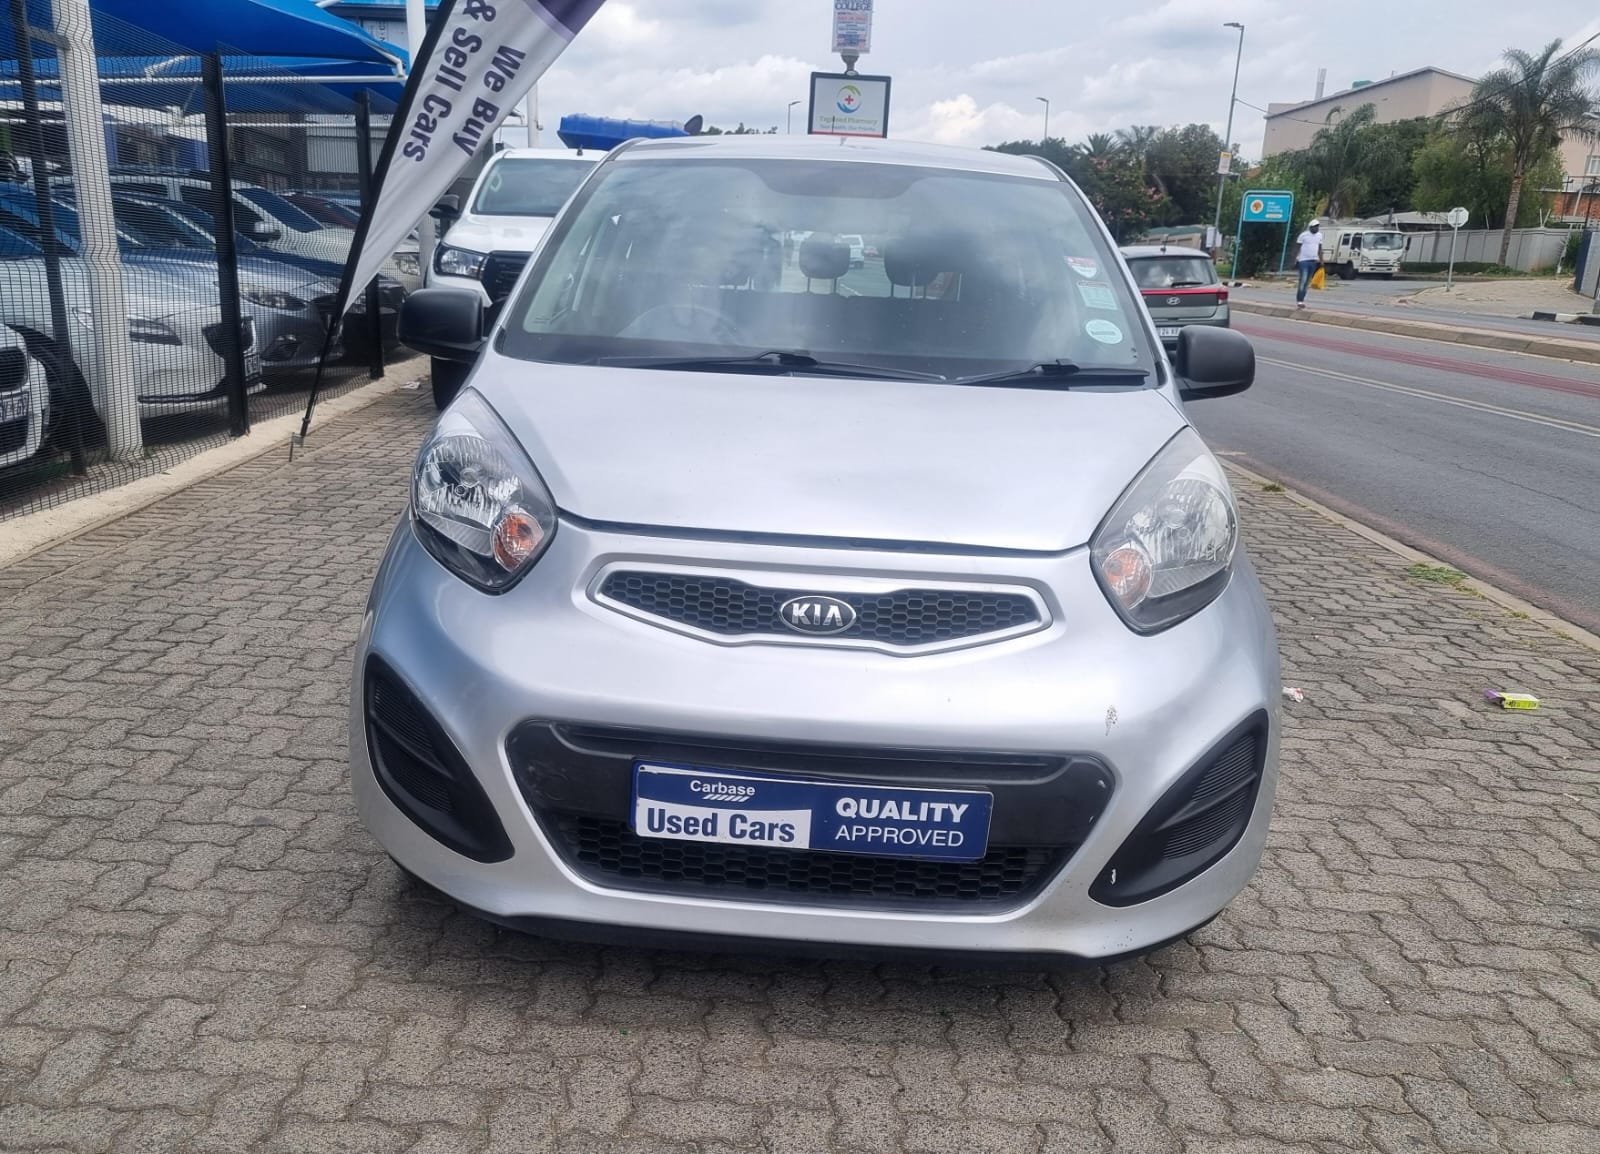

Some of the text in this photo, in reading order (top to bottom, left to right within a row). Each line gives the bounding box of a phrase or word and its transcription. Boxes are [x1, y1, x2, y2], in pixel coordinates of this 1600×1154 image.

[403, 0, 497, 162] & Sell Cars
[452, 45, 527, 157] We Buy
[791, 603, 844, 626] KIA
[690, 780, 756, 796] Carbase
[836, 797, 970, 823] QUALITY
[647, 807, 796, 843] Used Cars
[835, 824, 964, 848] APPROVED
